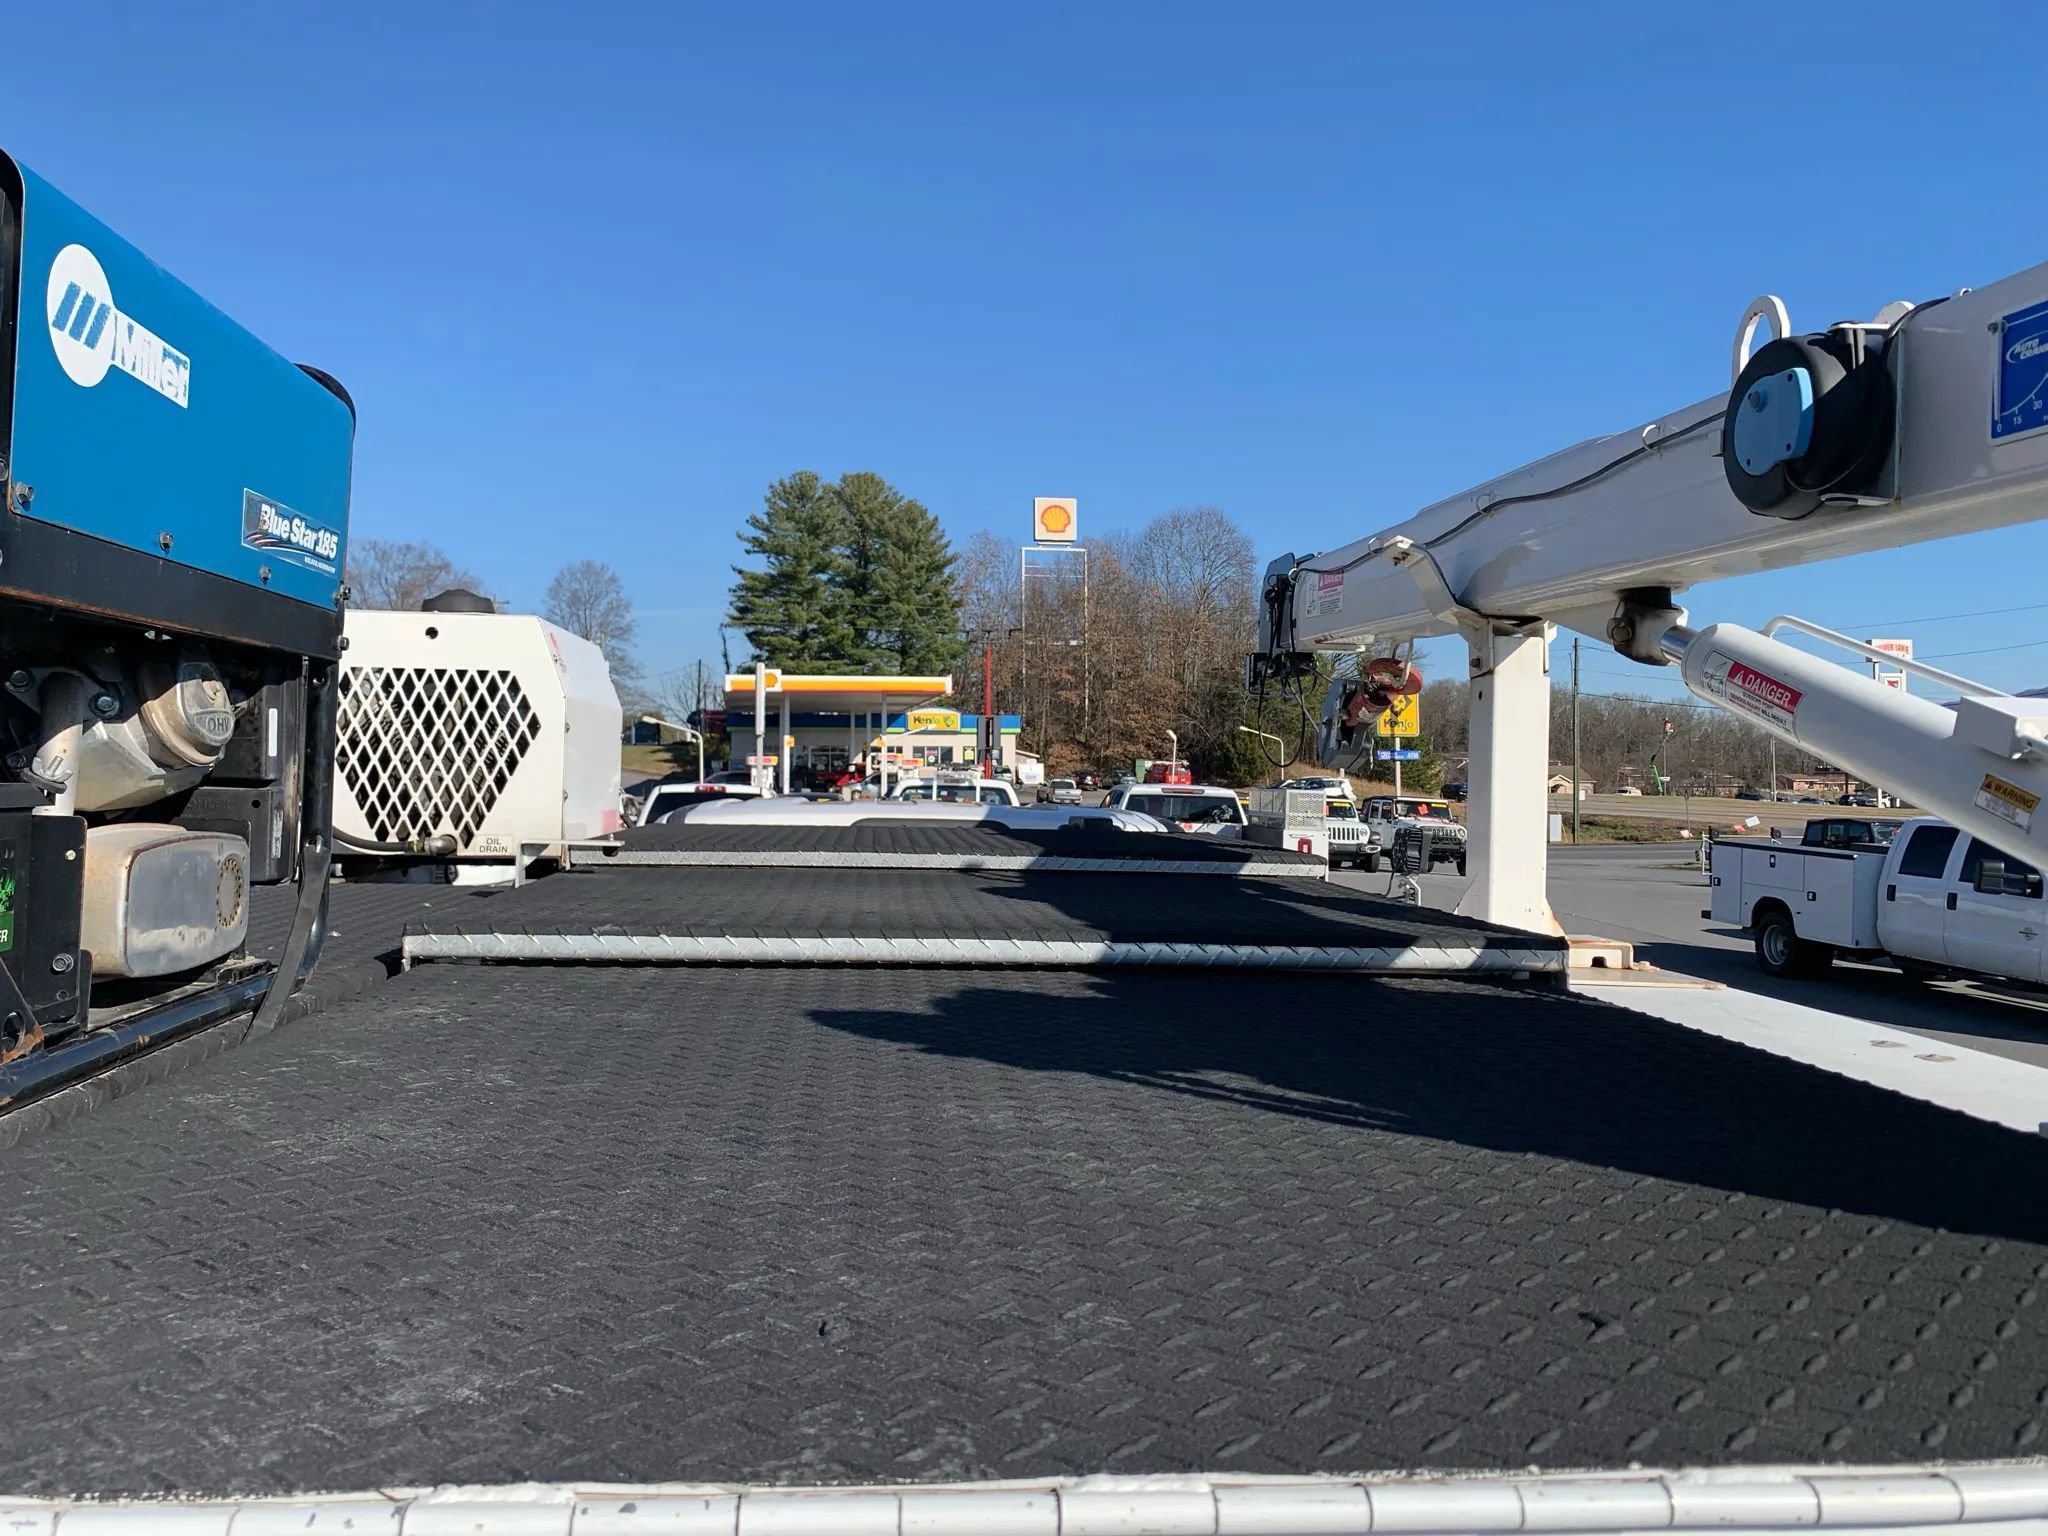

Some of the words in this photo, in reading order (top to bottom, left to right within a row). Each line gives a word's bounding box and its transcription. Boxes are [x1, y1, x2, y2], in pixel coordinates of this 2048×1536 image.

[2013, 338, 2040, 354] AUTO
[259, 503, 290, 539] Blue
[290, 517, 317, 550] Star
[316, 529, 339, 559] 185
[1744, 674, 1791, 707] DANGER
[207, 716, 229, 732] OHV
[1994, 783, 2035, 809] WARNING
[479, 845, 508, 853] DRAIN
[486, 837, 501, 845] OIL
